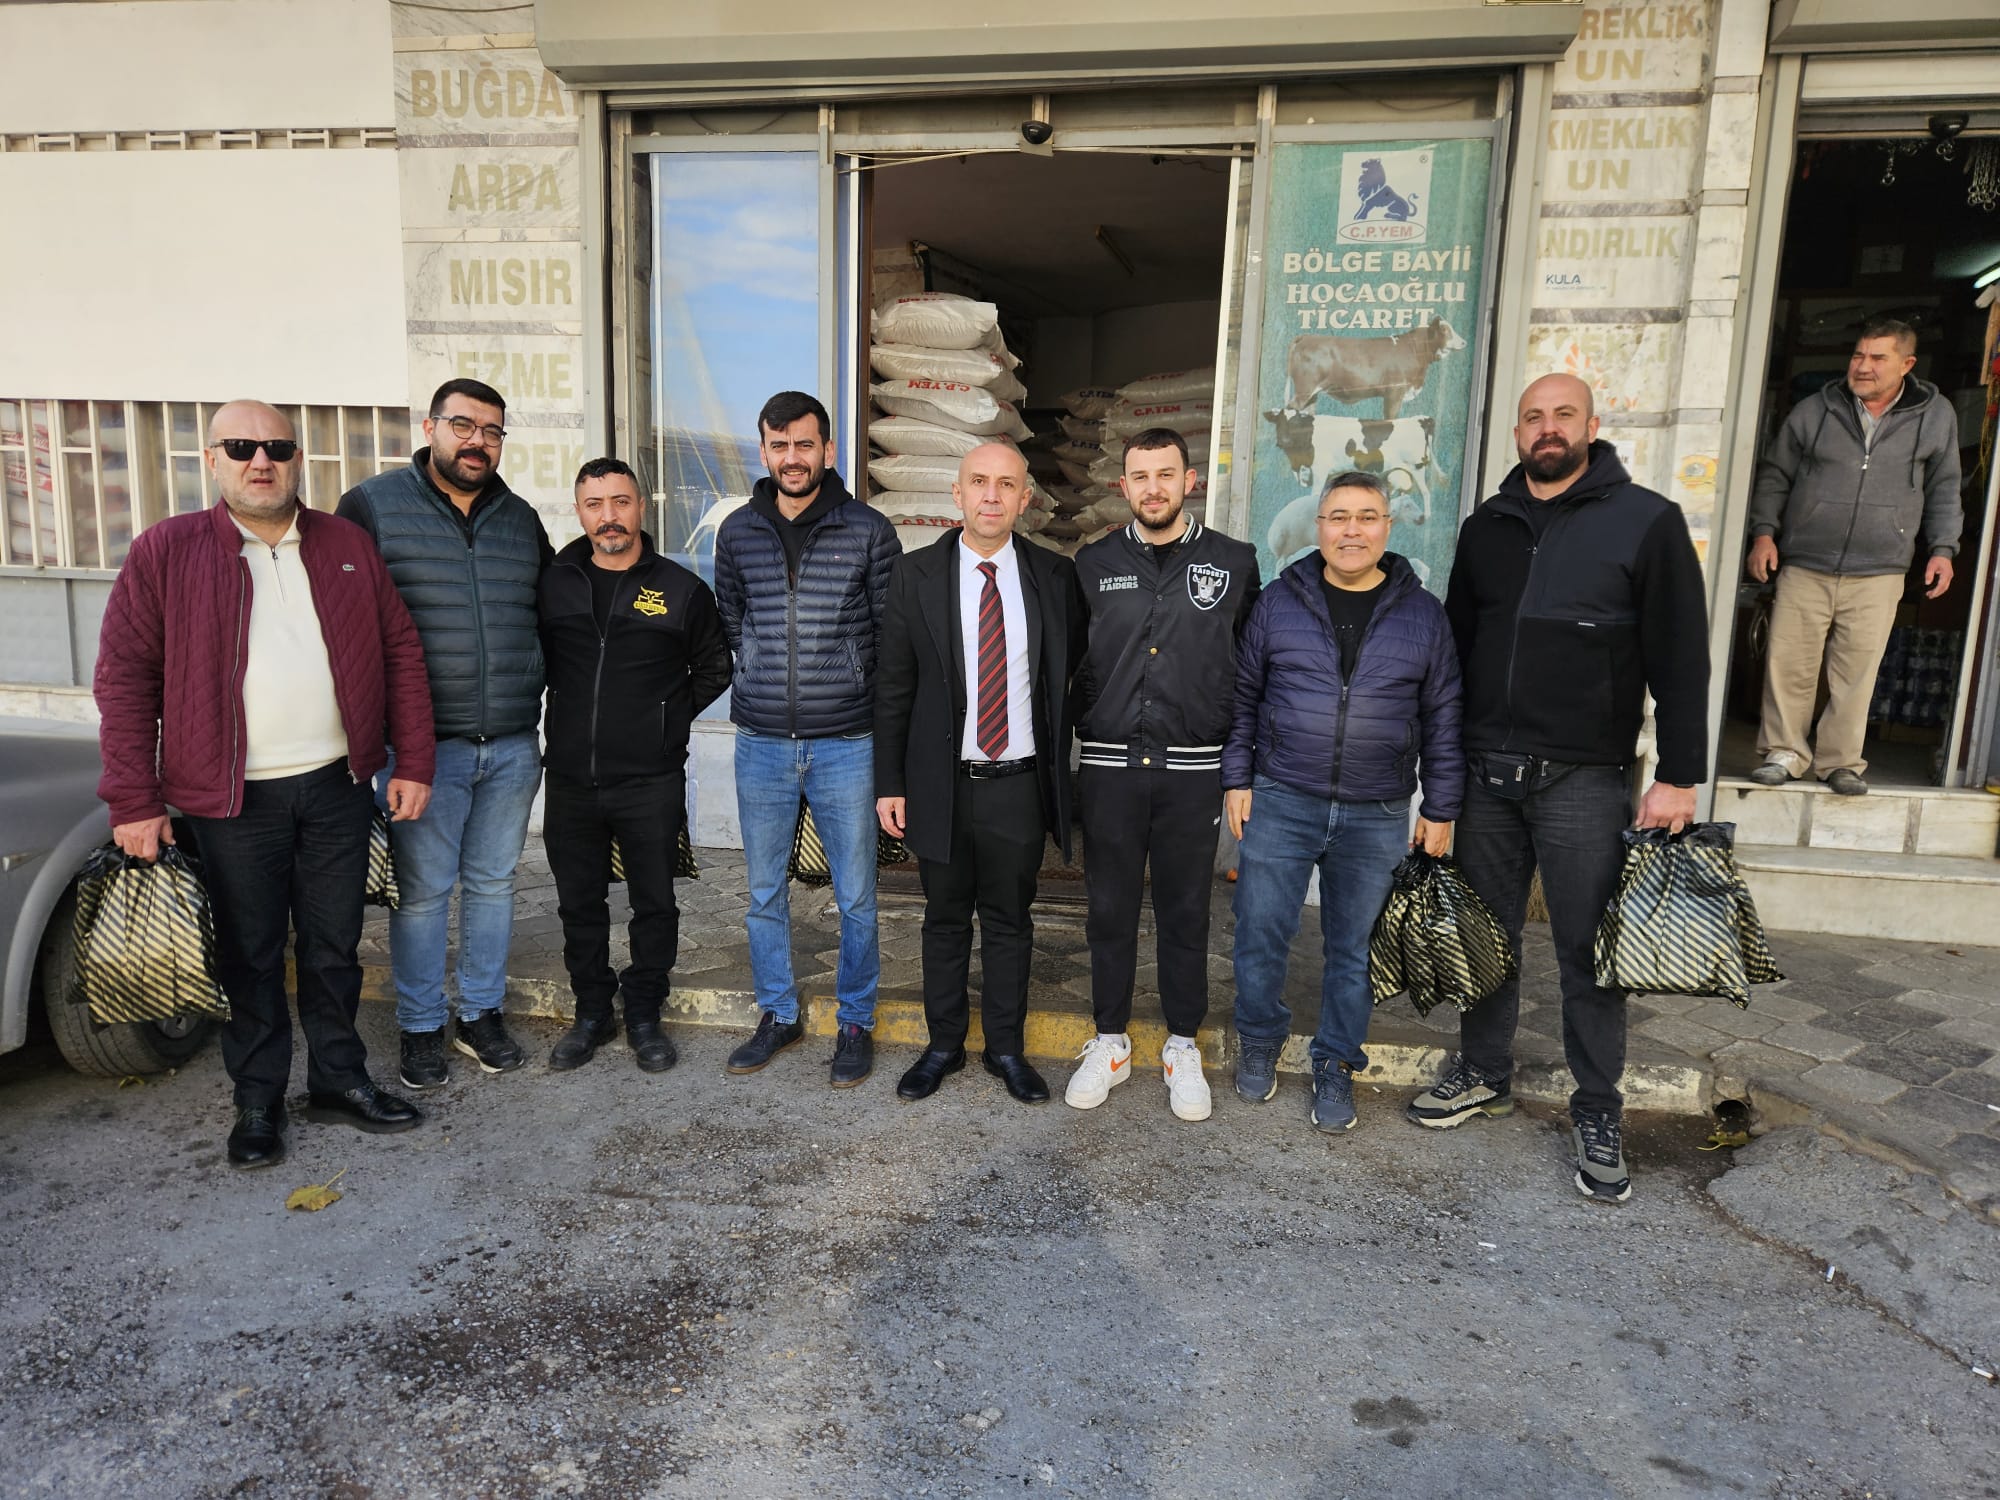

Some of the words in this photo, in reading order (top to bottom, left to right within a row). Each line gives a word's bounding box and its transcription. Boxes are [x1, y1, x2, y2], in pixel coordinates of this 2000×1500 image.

[1579, 4, 1698, 40] REKLİK
[1575, 49, 1644, 81] UN
[411, 61, 578, 118] BUĞDA
[448, 164, 563, 211] ARPA
[1567, 159, 1630, 190] UN
[1349, 226, 1413, 238] C.P.YEM
[1538, 226, 1680, 259] NDIRLIK
[1283, 248, 1382, 274] BÖLGE
[1391, 245, 1472, 272] BAYİİ
[449, 259, 573, 306] MISIR
[1286, 276, 1466, 304] HOCAOĞLU
[1545, 274, 1582, 284] KULA
[1297, 303, 1435, 329] TİCARET
[456, 352, 573, 399] EZME
[907, 379, 971, 392] C.P.YEM
[1134, 405, 1181, 417] C.P.YEM
[504, 442, 585, 488] PEK
[1099, 577, 1113, 585] LAS
[1113, 575, 1138, 583] VEGAS
[1099, 581, 1139, 592] RAIDERS
[1192, 567, 1225, 578] RAIDERS
